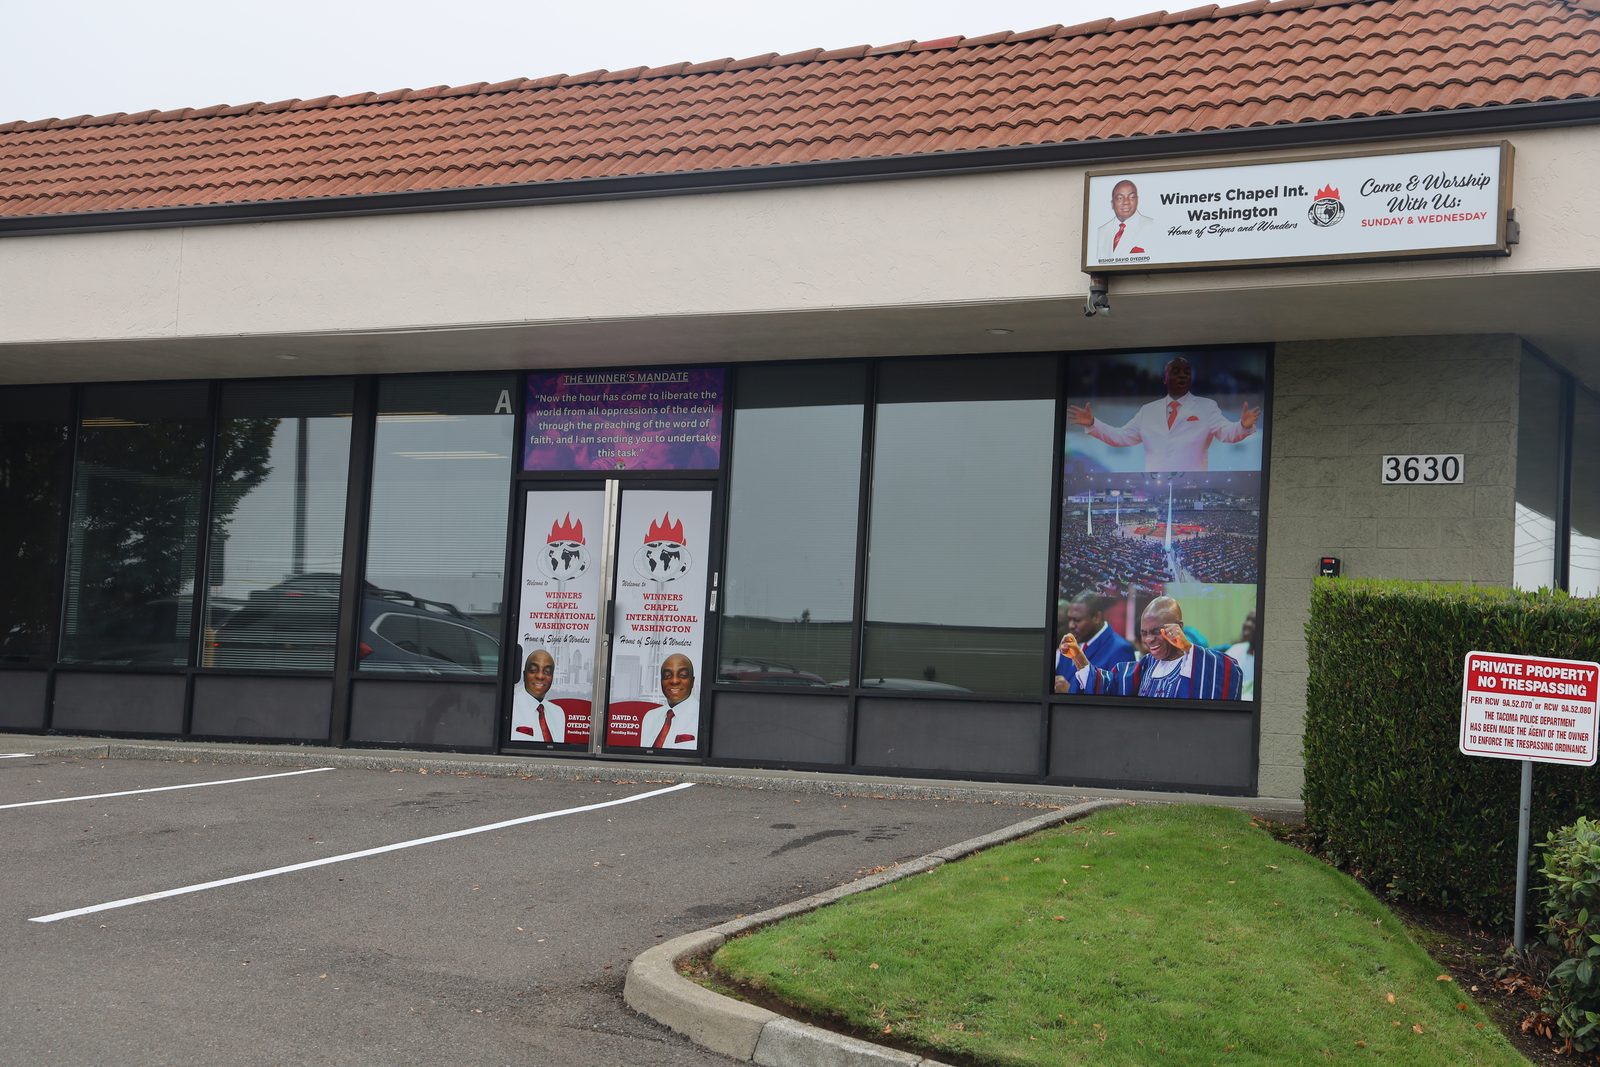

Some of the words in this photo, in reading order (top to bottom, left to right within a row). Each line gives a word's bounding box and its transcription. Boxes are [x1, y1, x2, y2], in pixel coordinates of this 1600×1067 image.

[1360, 178, 1402, 196] Come
[1406, 175, 1420, 191] &
[1422, 171, 1490, 190] Worship
[1160, 193, 1222, 206] Winners
[1226, 186, 1278, 202] Chapel
[1284, 184, 1308, 197] Int.
[1386, 194, 1428, 213] With
[1432, 193, 1462, 210] Us:
[1188, 205, 1278, 221] Washington
[1362, 216, 1404, 227] SUNDAY
[1407, 216, 1414, 224] &
[1418, 212, 1487, 224] WEDNESDAY
[1168, 226, 1192, 236] Home
[1194, 227, 1204, 238] of
[1208, 224, 1235, 237] Signs
[1237, 222, 1256, 232] and
[1257, 220, 1298, 232] Wonders
[564, 375, 583, 384] THE
[586, 374, 634, 382] WINNER'S
[638, 372, 688, 382] MANDATE
[494, 390, 512, 414] A
[661, 392, 698, 400] liberate
[701, 390, 717, 399] the
[536, 408, 562, 416] world
[564, 407, 586, 416] from
[588, 407, 599, 415] all
[602, 407, 658, 417] oppressions
[660, 405, 670, 414] of
[672, 405, 688, 413] the
[690, 404, 714, 413] devil
[538, 421, 574, 432] through
[577, 421, 592, 430] the
[594, 420, 640, 431] preaching
[642, 420, 653, 428] of
[655, 420, 670, 428] the
[673, 420, 697, 428] word
[700, 419, 710, 428] of
[530, 436, 554, 445] faith,
[556, 436, 573, 444] and
[596, 435, 633, 445] sending
[635, 436, 652, 445] you
[668, 434, 716, 442] undertake
[598, 449, 615, 457] this
[1386, 456, 1460, 482] 3630
[530, 612, 596, 620] INTERNATIONAL
[626, 614, 698, 622] INTERNATIONAL
[631, 624, 691, 632] WASHINGTON
[524, 633, 538, 642] Home
[540, 634, 545, 645] of
[546, 634, 561, 645] Signs
[564, 634, 568, 642] &
[569, 634, 590, 643] Wonders
[620, 635, 635, 644] Home
[637, 637, 643, 647] of
[645, 637, 660, 647] Signs
[662, 637, 668, 645] &
[668, 637, 691, 646] Wonders
[1472, 660, 1522, 676] PRIVATE
[1526, 665, 1595, 682] PROPERTY
[1478, 676, 1496, 688] NO
[1501, 678, 1587, 696] TRESPASSING
[1470, 696, 1482, 704] PER
[1485, 698, 1500, 706] RCW
[1502, 699, 1532, 709] 9A.52.070
[1544, 702, 1558, 712] RCW
[1561, 704, 1591, 714] 9A.52.080
[1485, 711, 1494, 719] THE
[1496, 712, 1518, 722] TACOMA
[1520, 714, 1538, 724] POLICE
[1540, 716, 1576, 728] DEPARTMENT
[1470, 722, 1482, 732] HAS
[1483, 724, 1497, 733] BEEN
[1499, 725, 1514, 735] MADE
[1516, 727, 1526, 736] THE
[1528, 728, 1546, 738] AGENT
[1548, 730, 1554, 739] OF
[1557, 731, 1566, 740] THE
[1568, 732, 1589, 742] OWNER
[1470, 735, 1476, 744] TO
[1478, 736, 1502, 746] ENFORCE
[1504, 738, 1514, 747] THE
[1516, 740, 1554, 751] TRESPASSING
[1555, 743, 1588, 754] ORDINANCE.
